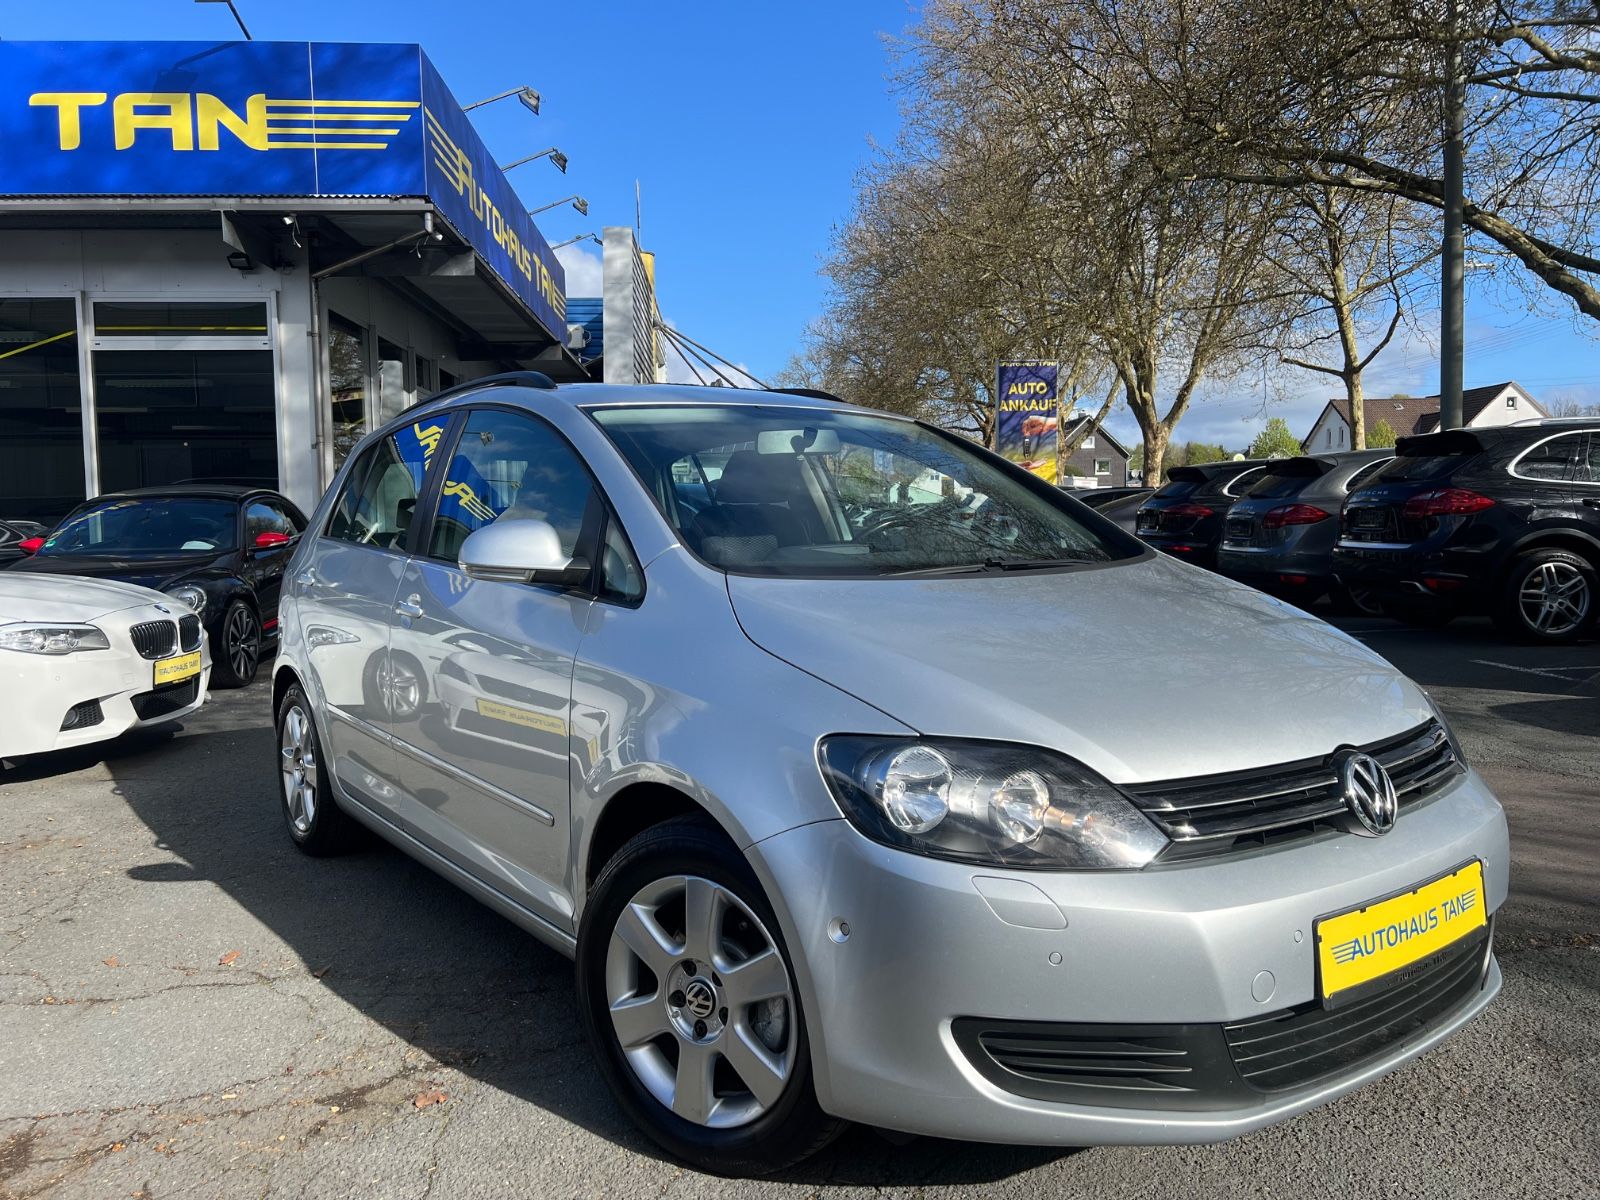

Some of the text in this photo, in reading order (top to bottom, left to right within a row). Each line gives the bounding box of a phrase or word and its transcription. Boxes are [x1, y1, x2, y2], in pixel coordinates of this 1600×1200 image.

[29, 92, 270, 151] TAN
[457, 147, 560, 312] AUTOHAUS TAN
[1000, 398, 1057, 412] ANKAUF
[1008, 382, 1048, 395] AUTO
[1351, 893, 1466, 961] AUTOHAUS TAN
